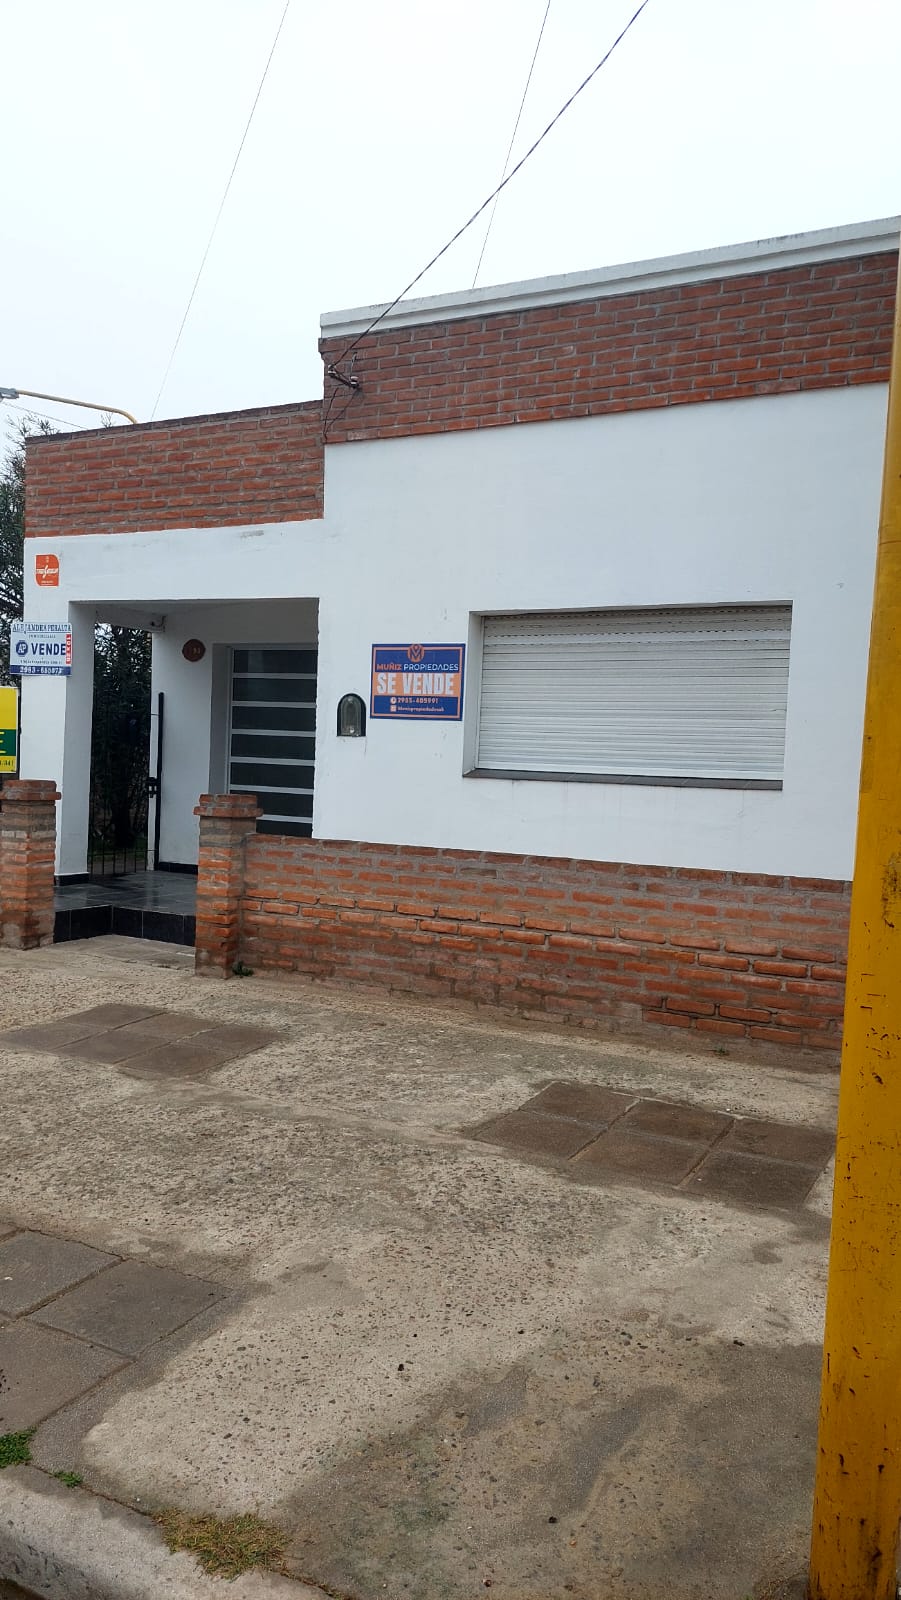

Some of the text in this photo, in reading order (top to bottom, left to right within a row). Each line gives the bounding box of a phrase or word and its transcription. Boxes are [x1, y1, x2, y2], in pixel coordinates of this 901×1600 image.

[31, 643, 66, 656] VENDE
[376, 662, 459, 671] MUÑIZ PROPIEDADES
[376, 672, 455, 695] SE VENDE
